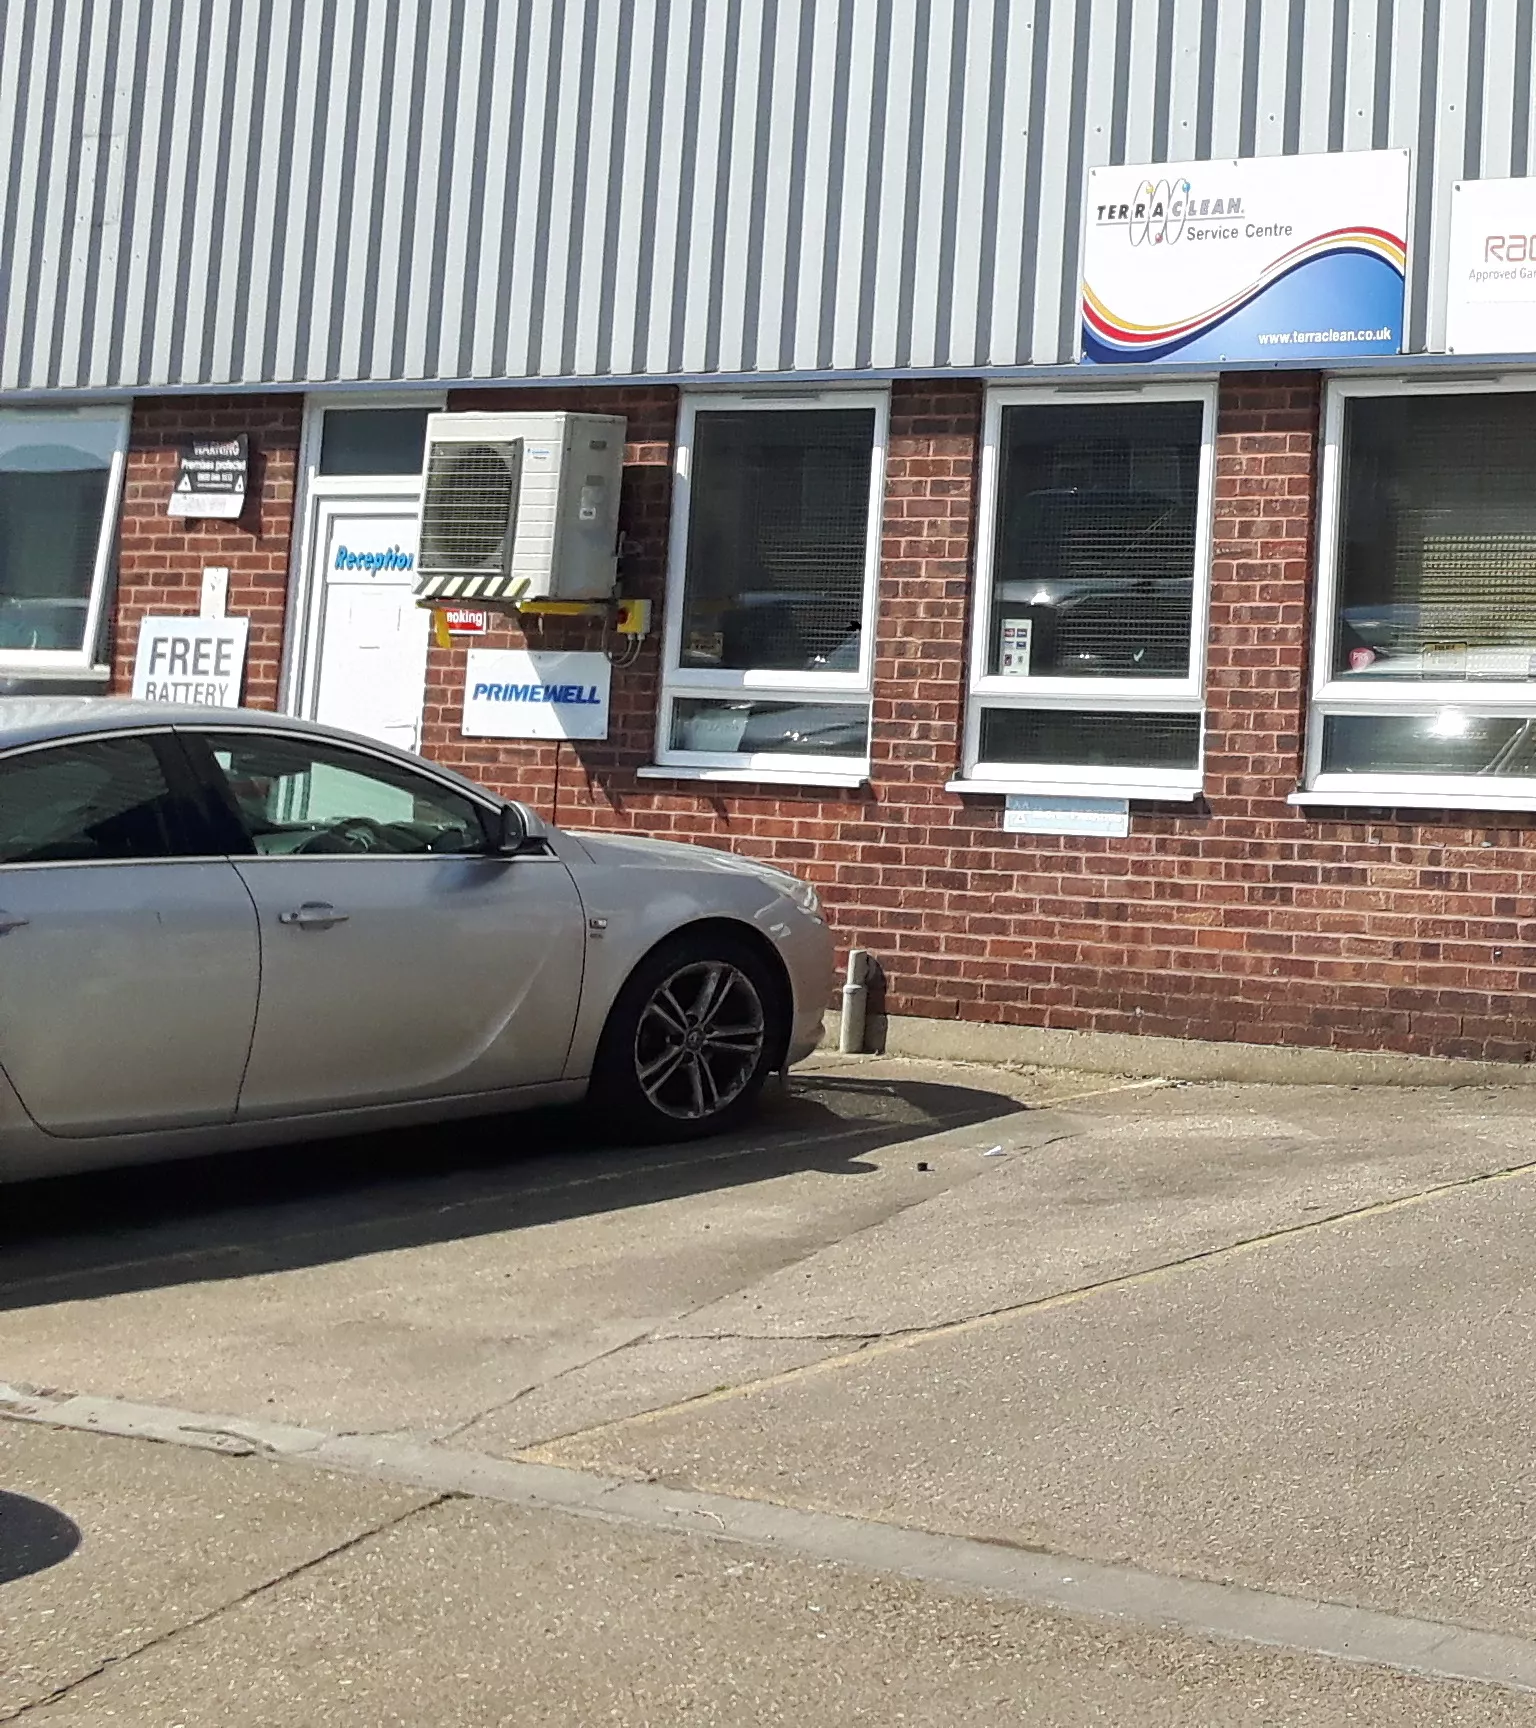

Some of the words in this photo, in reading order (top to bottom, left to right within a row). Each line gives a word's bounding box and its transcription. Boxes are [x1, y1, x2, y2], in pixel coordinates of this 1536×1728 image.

[1186, 225, 1239, 241] Service
[1245, 223, 1292, 238] Centre
[1468, 267, 1517, 283] Approved
[1257, 326, 1392, 346] www.terraclean.co.uk
[149, 637, 234, 677] FREE
[472, 682, 601, 705] PRIMEWELL
